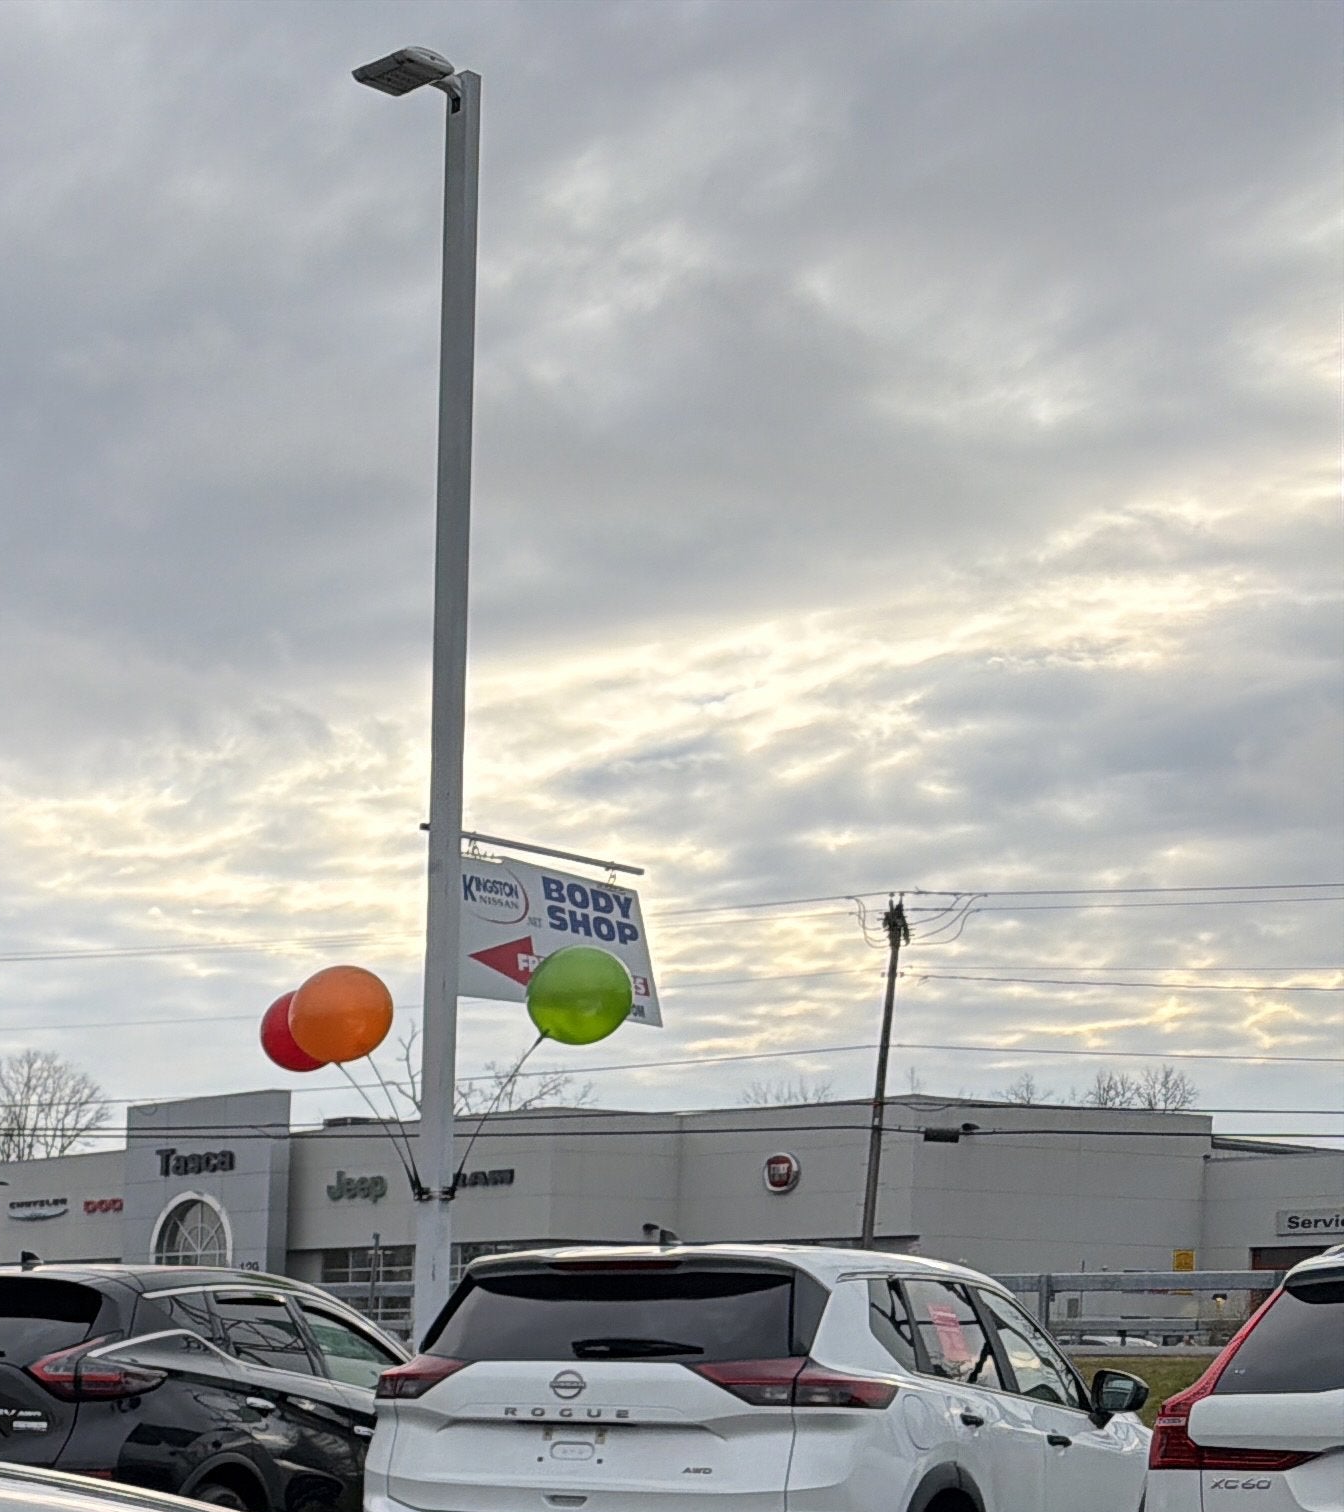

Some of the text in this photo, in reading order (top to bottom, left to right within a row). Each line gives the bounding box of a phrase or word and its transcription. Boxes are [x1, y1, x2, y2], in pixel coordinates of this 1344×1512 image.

[462, 873, 520, 903] KINGSTON
[541, 875, 633, 920] BODY
[478, 894, 520, 911] NISSAN
[546, 904, 640, 946] SHOP
[156, 1148, 236, 1178] Tasca
[326, 1170, 389, 1203] Jeep
[8, 1197, 68, 1209] CHRYSLER
[504, 1406, 630, 1419] ROGUE
[681, 1466, 713, 1475] AWD
[1210, 1478, 1272, 1490] XC60
